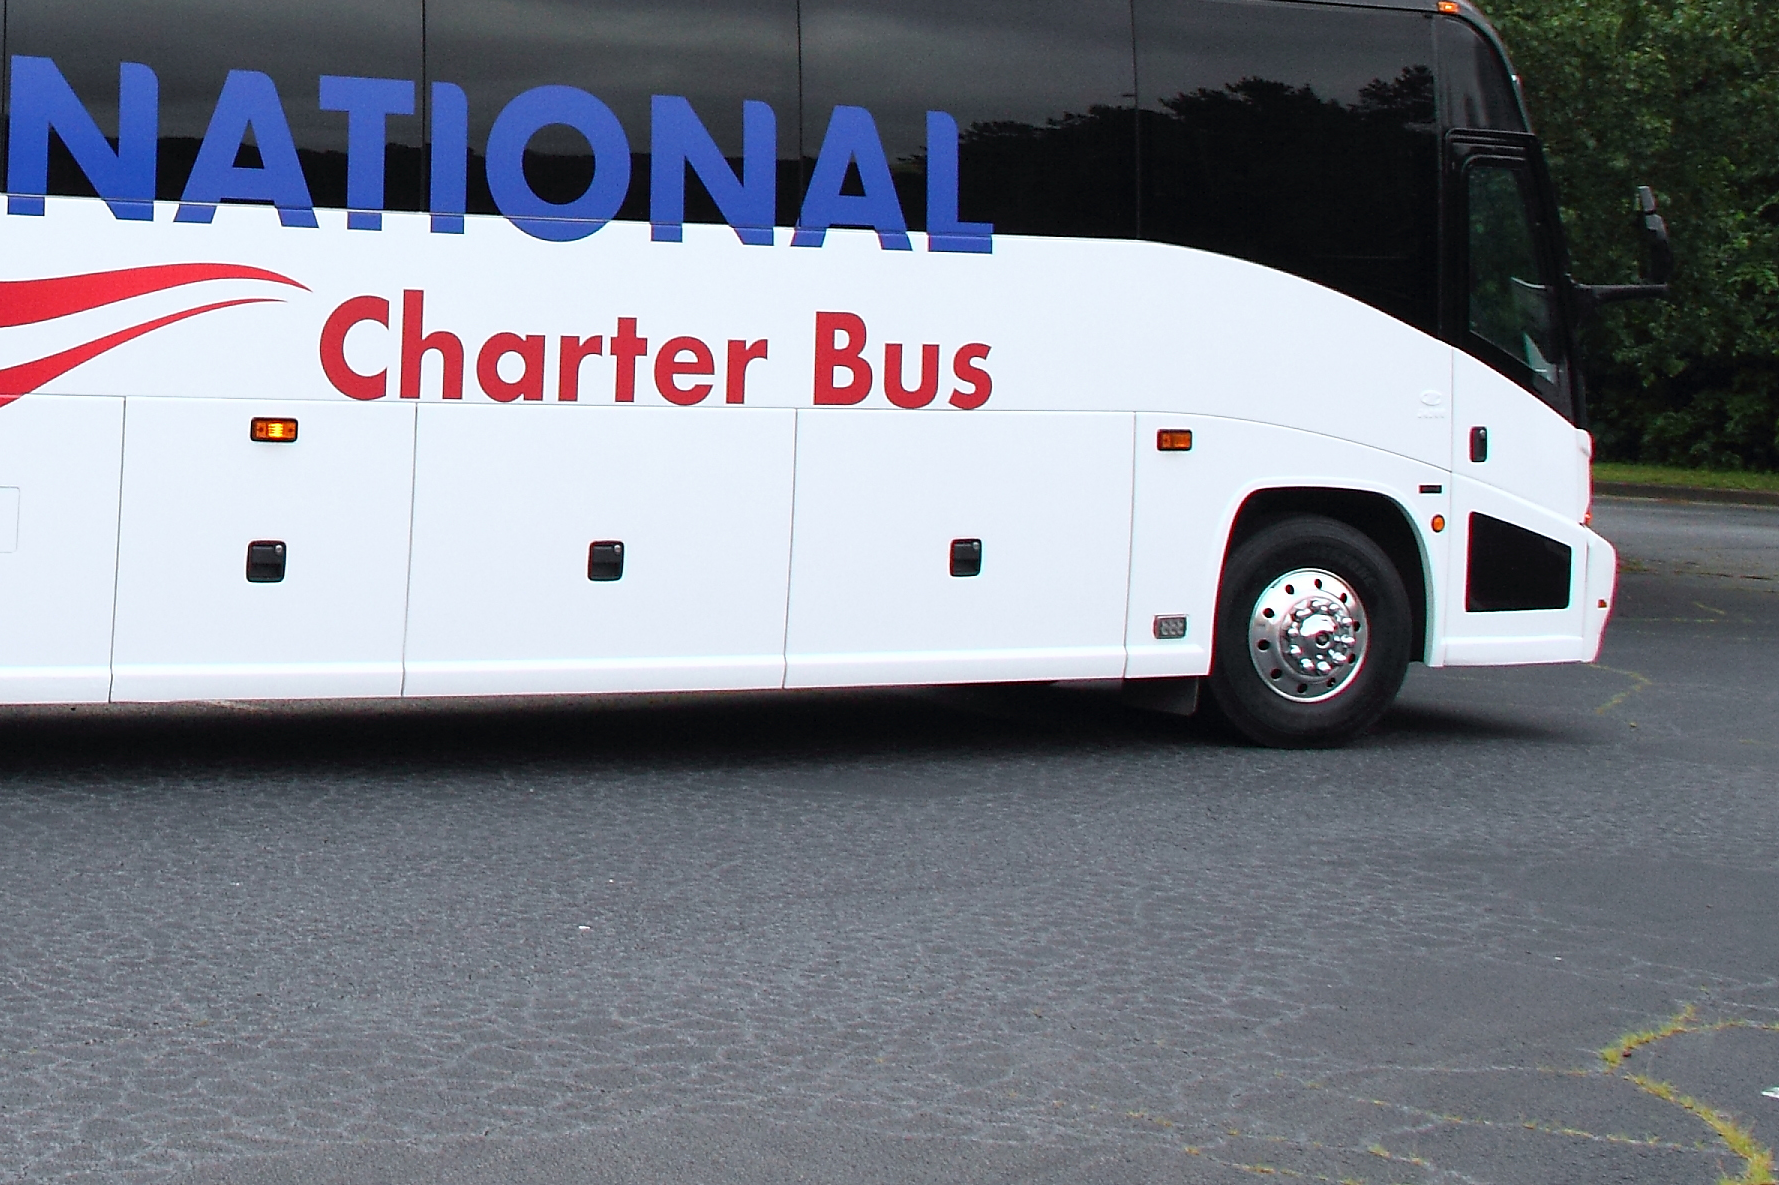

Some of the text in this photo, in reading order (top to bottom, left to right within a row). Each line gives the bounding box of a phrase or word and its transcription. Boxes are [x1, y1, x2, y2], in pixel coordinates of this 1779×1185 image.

[7, 54, 994, 253] NATIONAL
[319, 289, 993, 410] Charter Bus
